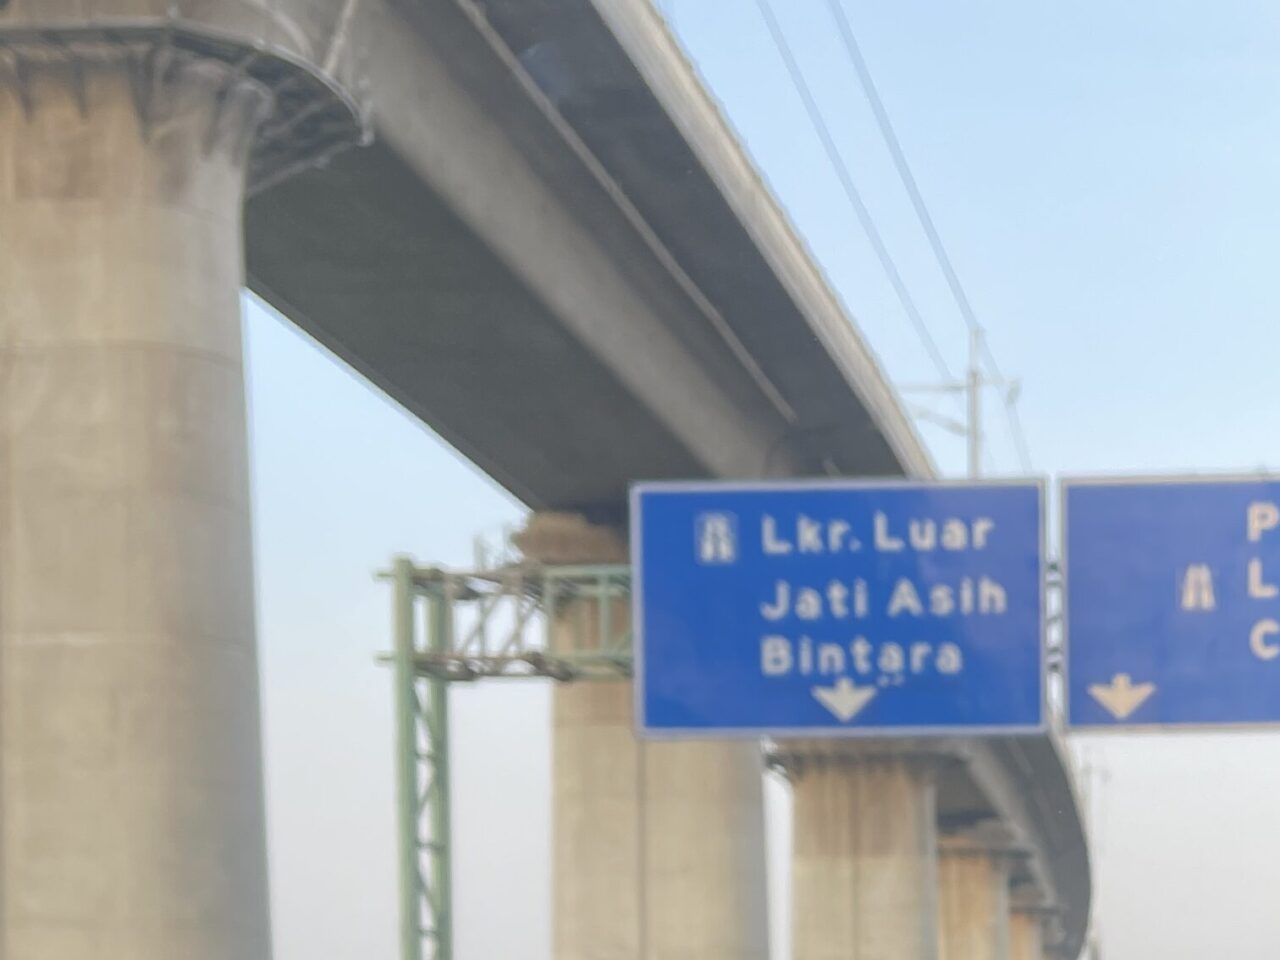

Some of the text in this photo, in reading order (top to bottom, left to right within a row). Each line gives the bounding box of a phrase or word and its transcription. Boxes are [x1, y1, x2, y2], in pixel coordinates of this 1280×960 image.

[760, 510, 993, 555] Lkr. Luar
[760, 575, 1007, 622] Jati Asih
[760, 635, 963, 677] Bintara
